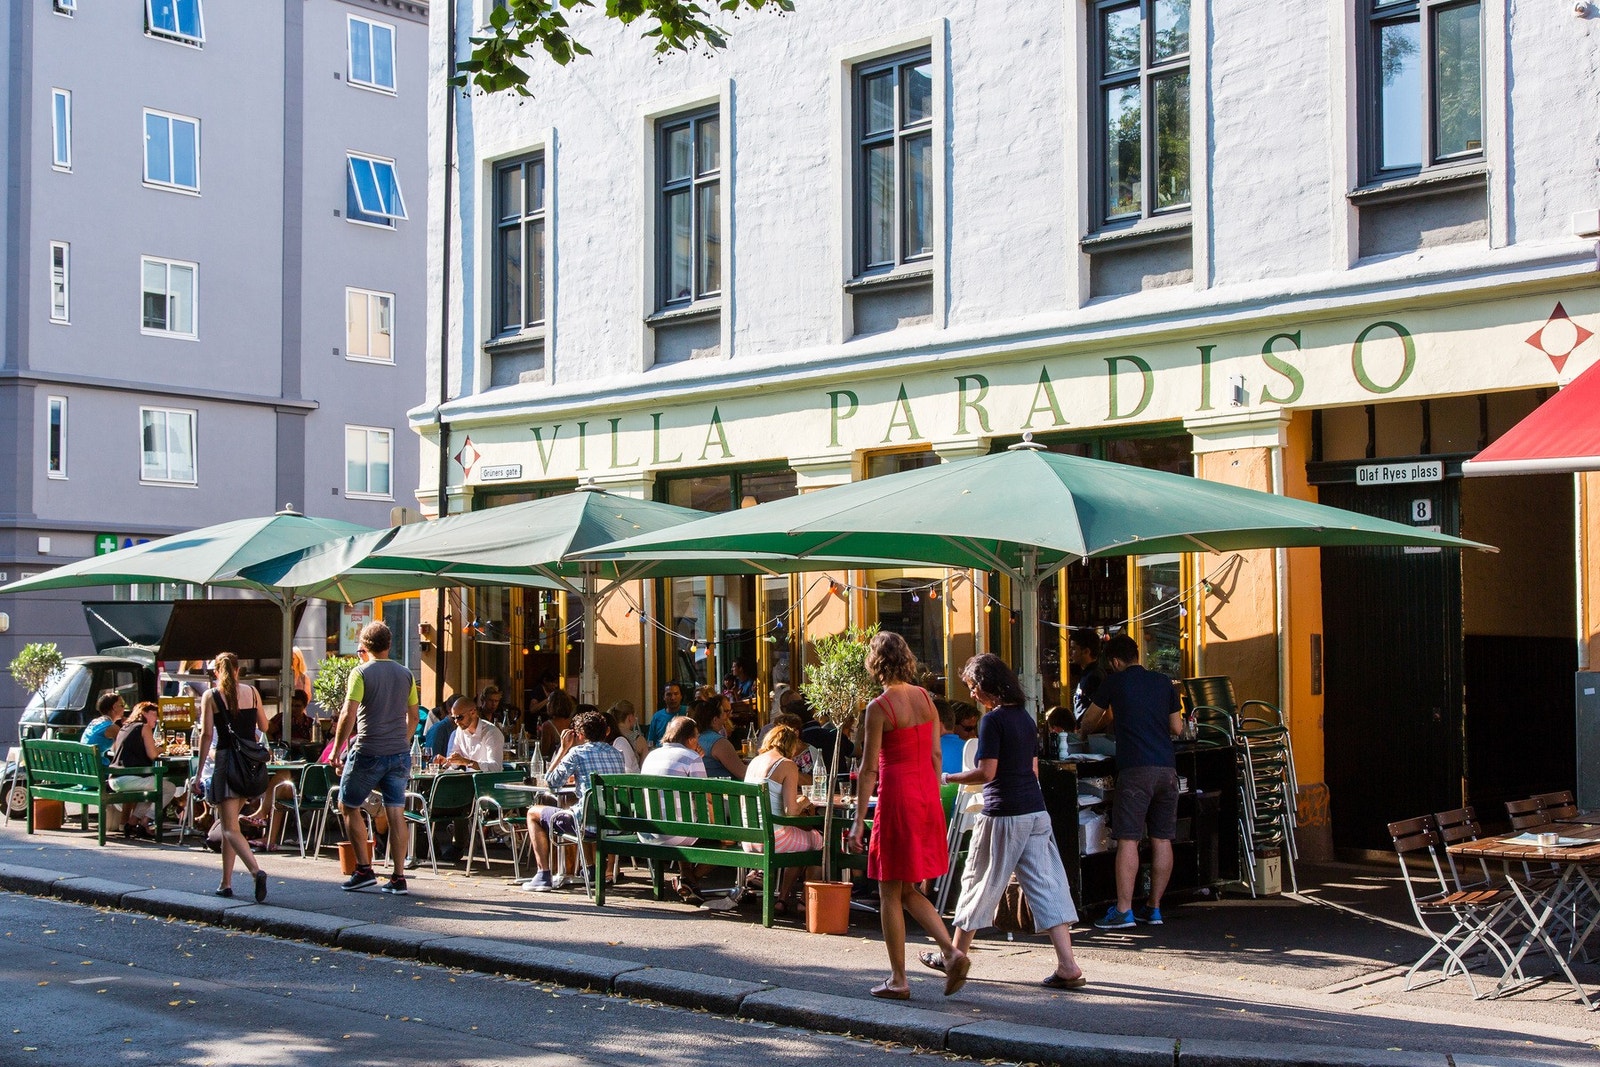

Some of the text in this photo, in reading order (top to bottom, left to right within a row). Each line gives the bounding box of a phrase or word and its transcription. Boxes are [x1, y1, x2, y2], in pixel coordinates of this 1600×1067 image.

[530, 320, 1417, 476] VILLA PARADISO
[506, 468, 518, 478] gate
[1359, 464, 1438, 482] Olaf Ryes plass
[1416, 501, 1427, 518] 8
